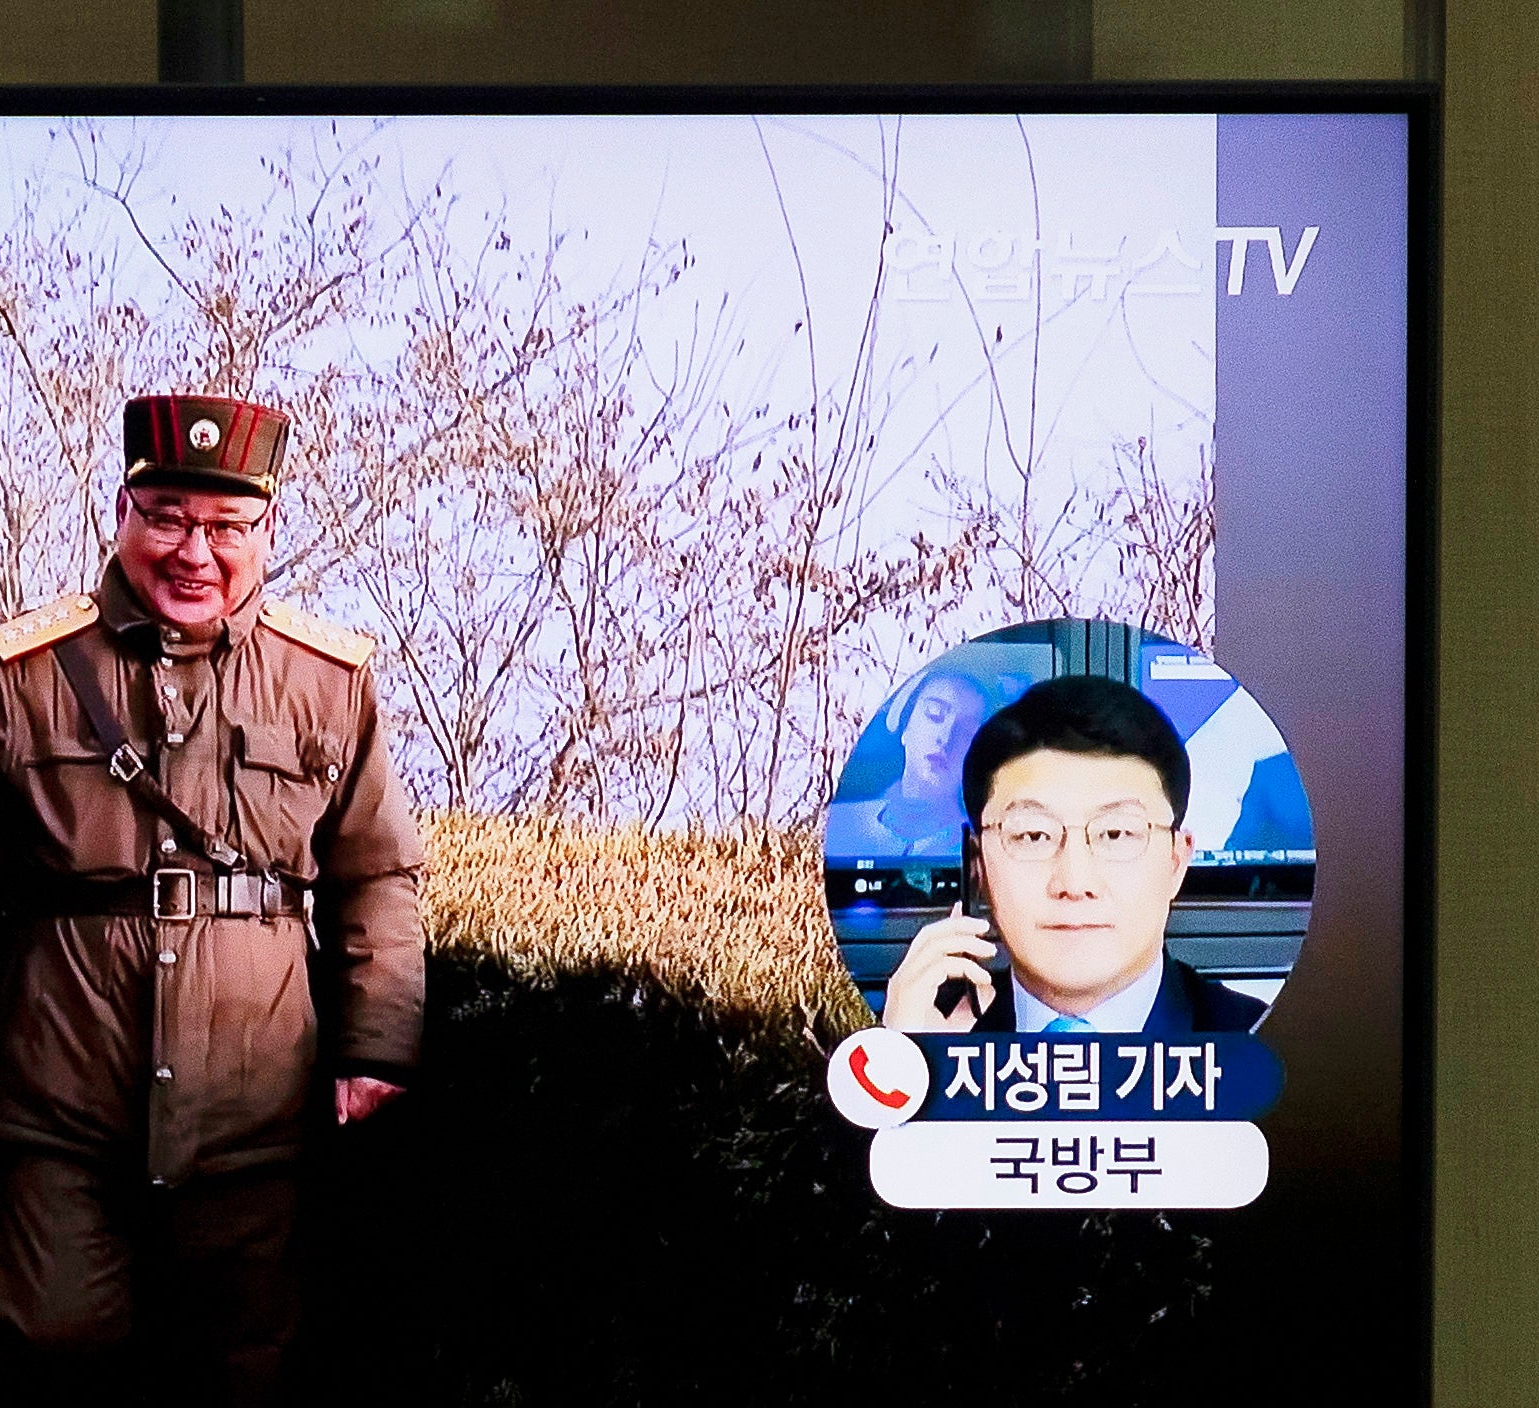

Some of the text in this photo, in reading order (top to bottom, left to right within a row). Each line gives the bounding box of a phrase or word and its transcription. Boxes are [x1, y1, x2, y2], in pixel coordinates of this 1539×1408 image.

[946, 1041, 1222, 1112] 지성림 기자
[990, 1135, 1162, 1194] 국방부
